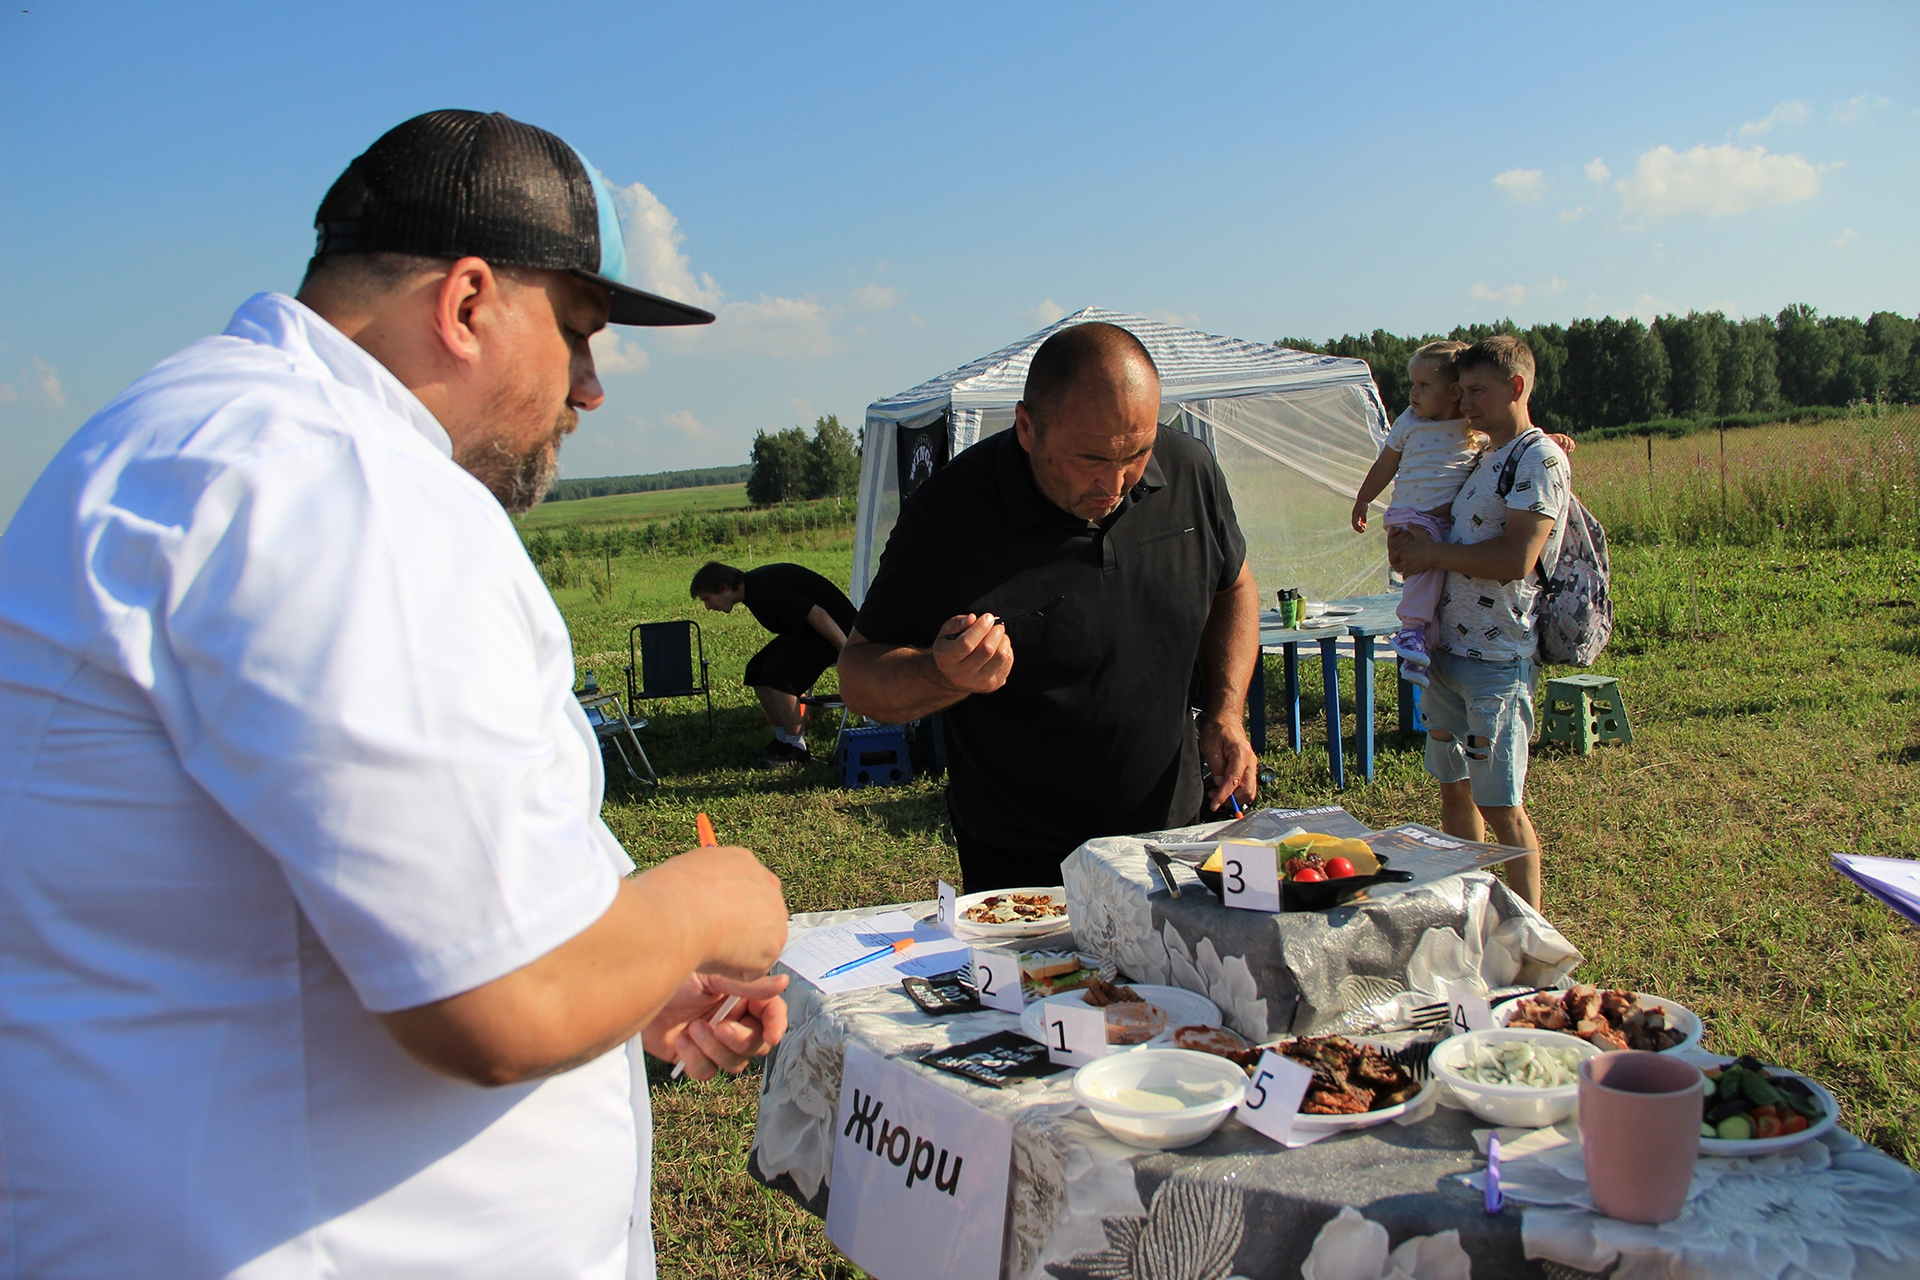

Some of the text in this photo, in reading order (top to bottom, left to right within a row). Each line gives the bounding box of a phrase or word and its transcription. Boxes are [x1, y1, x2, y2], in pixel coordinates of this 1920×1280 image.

[1227, 859, 1245, 894] 3
[938, 895, 945, 922] 6
[978, 965, 997, 997] 2
[1454, 1004, 1471, 1033] 4
[1051, 1020, 1073, 1053] 1
[1245, 1071, 1274, 1110] 5
[843, 1087, 963, 1197] Жюри
